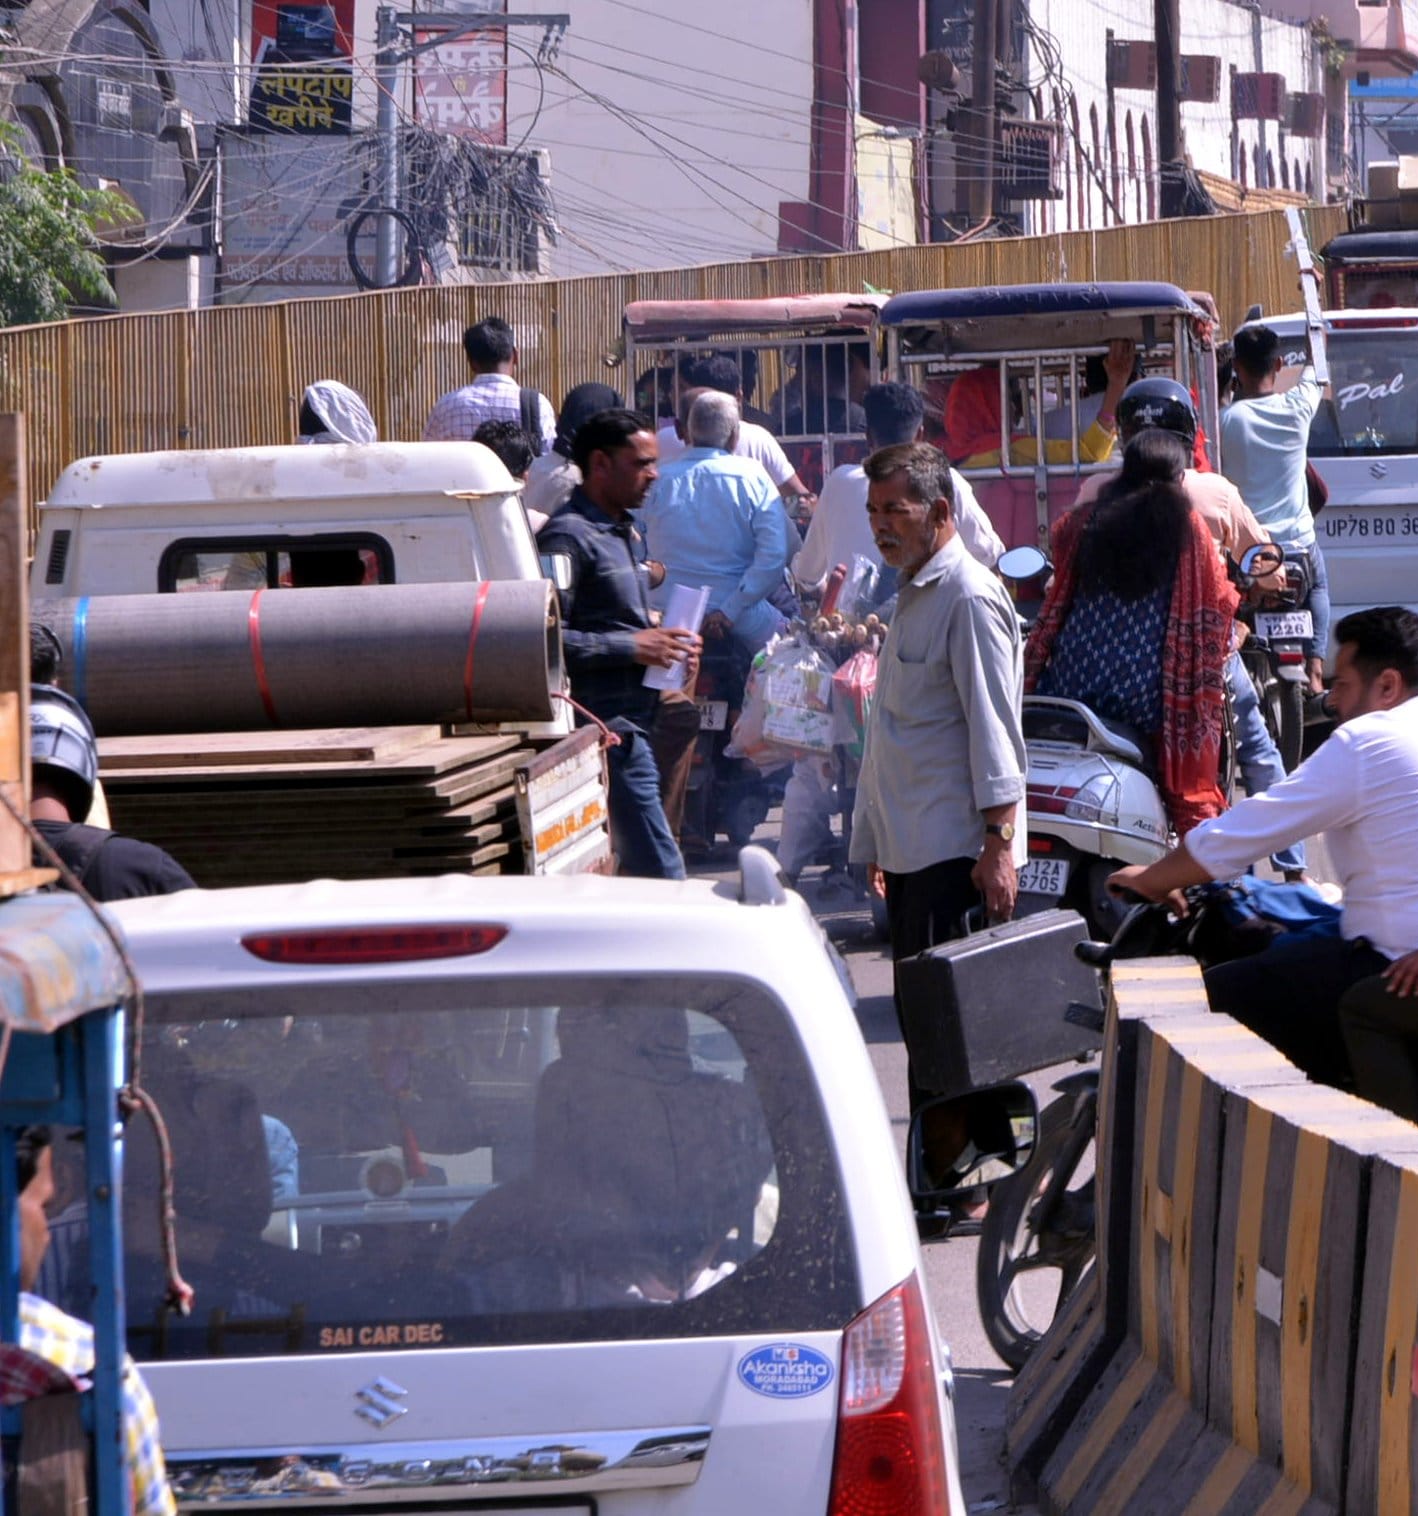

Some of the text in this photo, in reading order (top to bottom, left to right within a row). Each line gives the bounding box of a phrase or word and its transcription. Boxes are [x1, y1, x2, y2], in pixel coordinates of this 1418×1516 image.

[1284, 351, 1307, 368] Pa
[1337, 373, 1405, 410] Pal
[1325, 517, 1369, 538] UP78
[1266, 623, 1305, 636] 1226
[1015, 860, 1060, 877] P12A
[1018, 874, 1059, 892] 6705
[320, 1322, 443, 1348] SAI CAR DEC
[743, 1359, 827, 1376] Akanksha
[754, 1375, 819, 1385] MORADABAD
